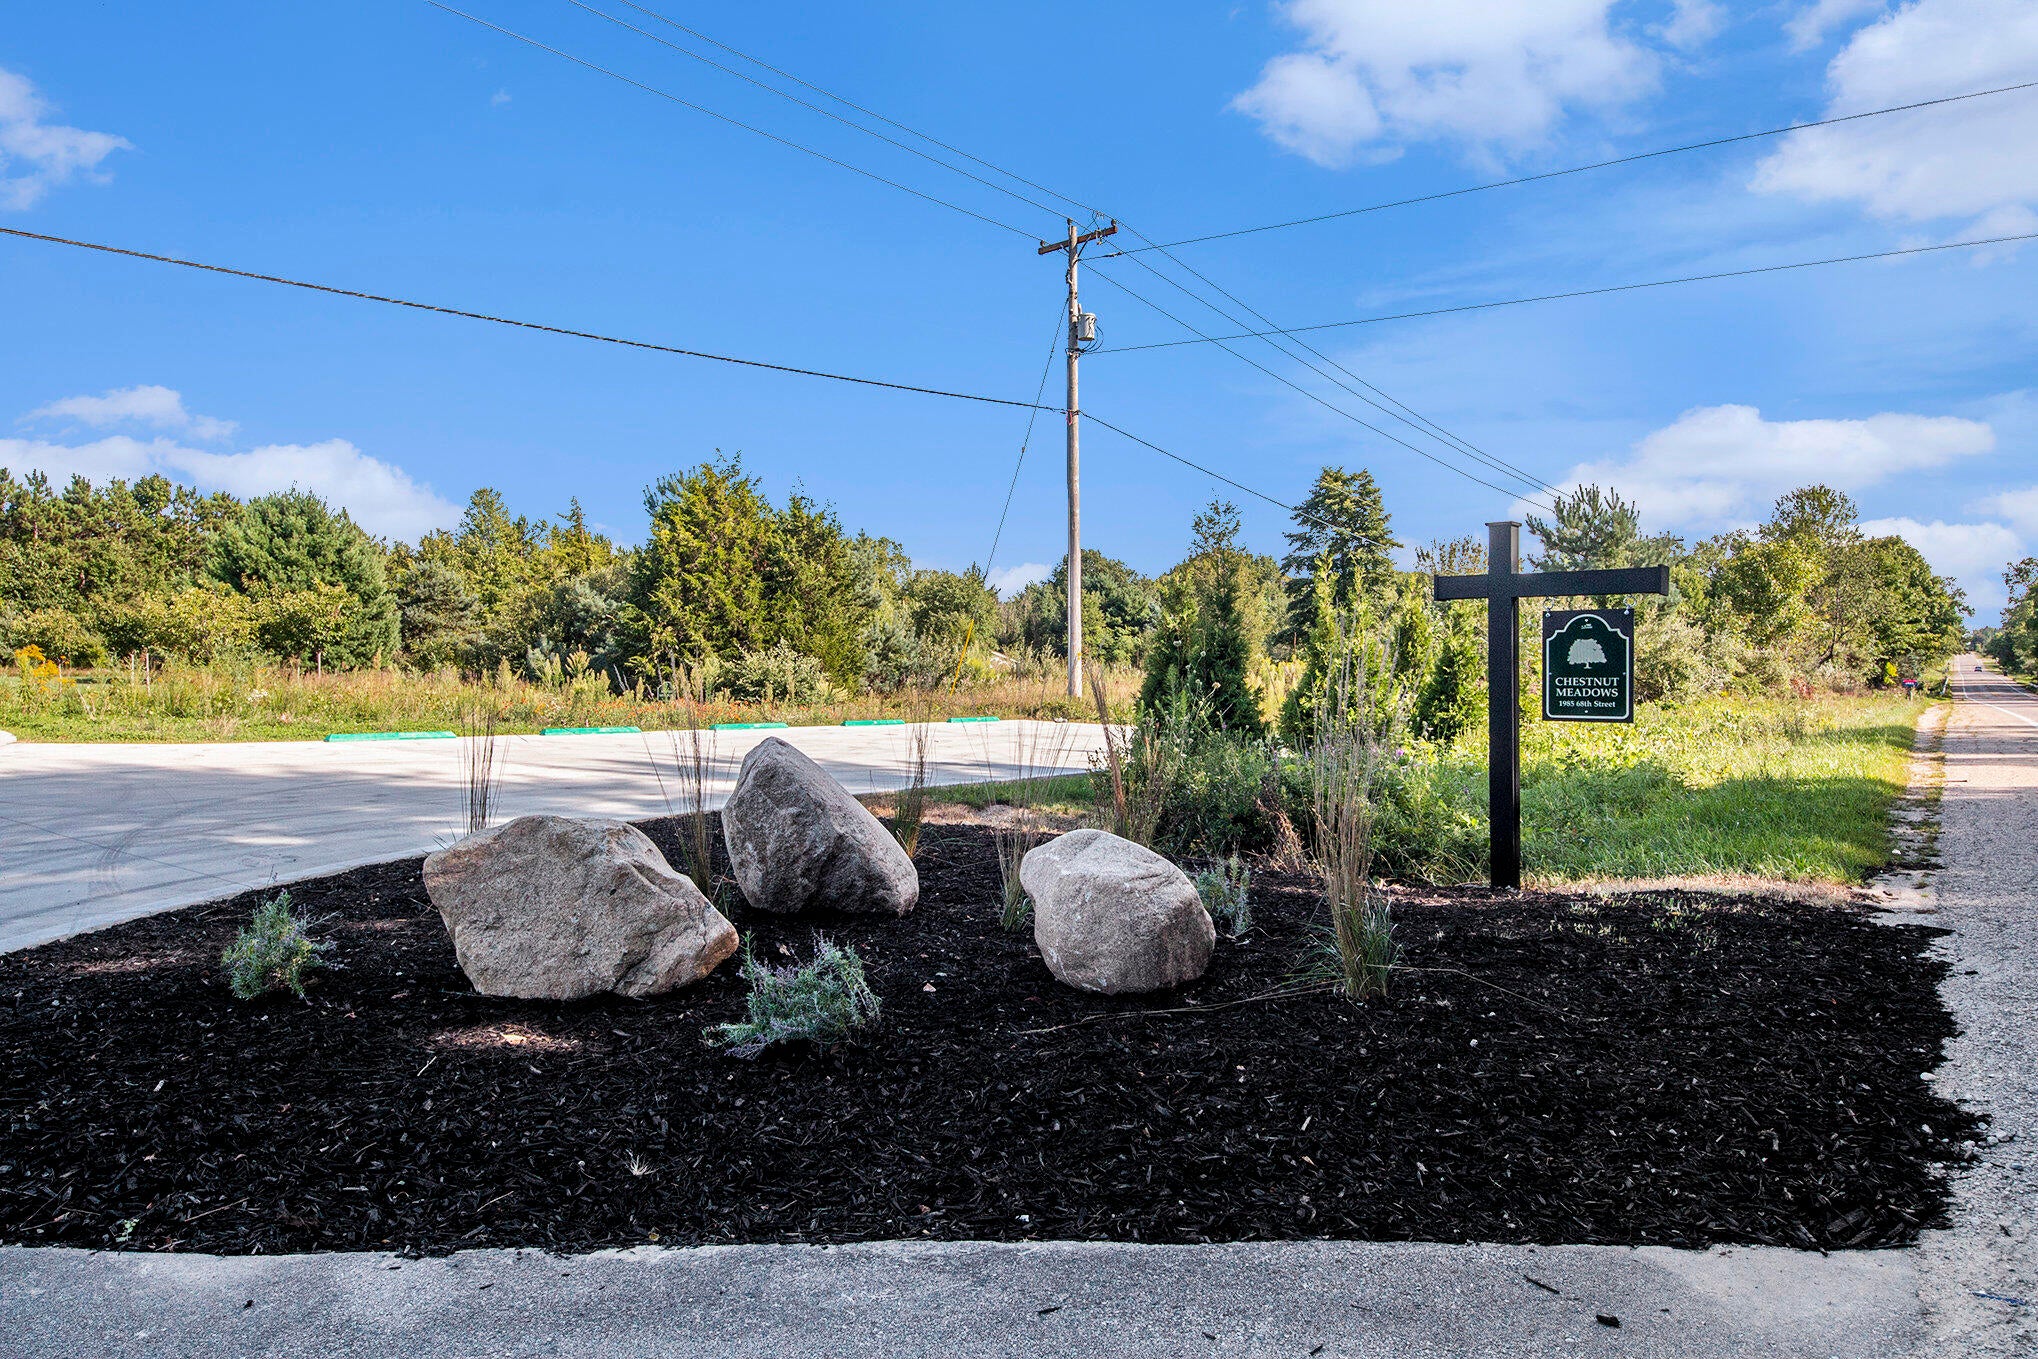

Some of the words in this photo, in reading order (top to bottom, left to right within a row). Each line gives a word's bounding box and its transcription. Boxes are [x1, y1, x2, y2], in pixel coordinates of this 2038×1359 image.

[1555, 677, 1619, 686] CHESTNUT
[1556, 688, 1618, 697] MEADOWS
[1593, 700, 1616, 708] Street
